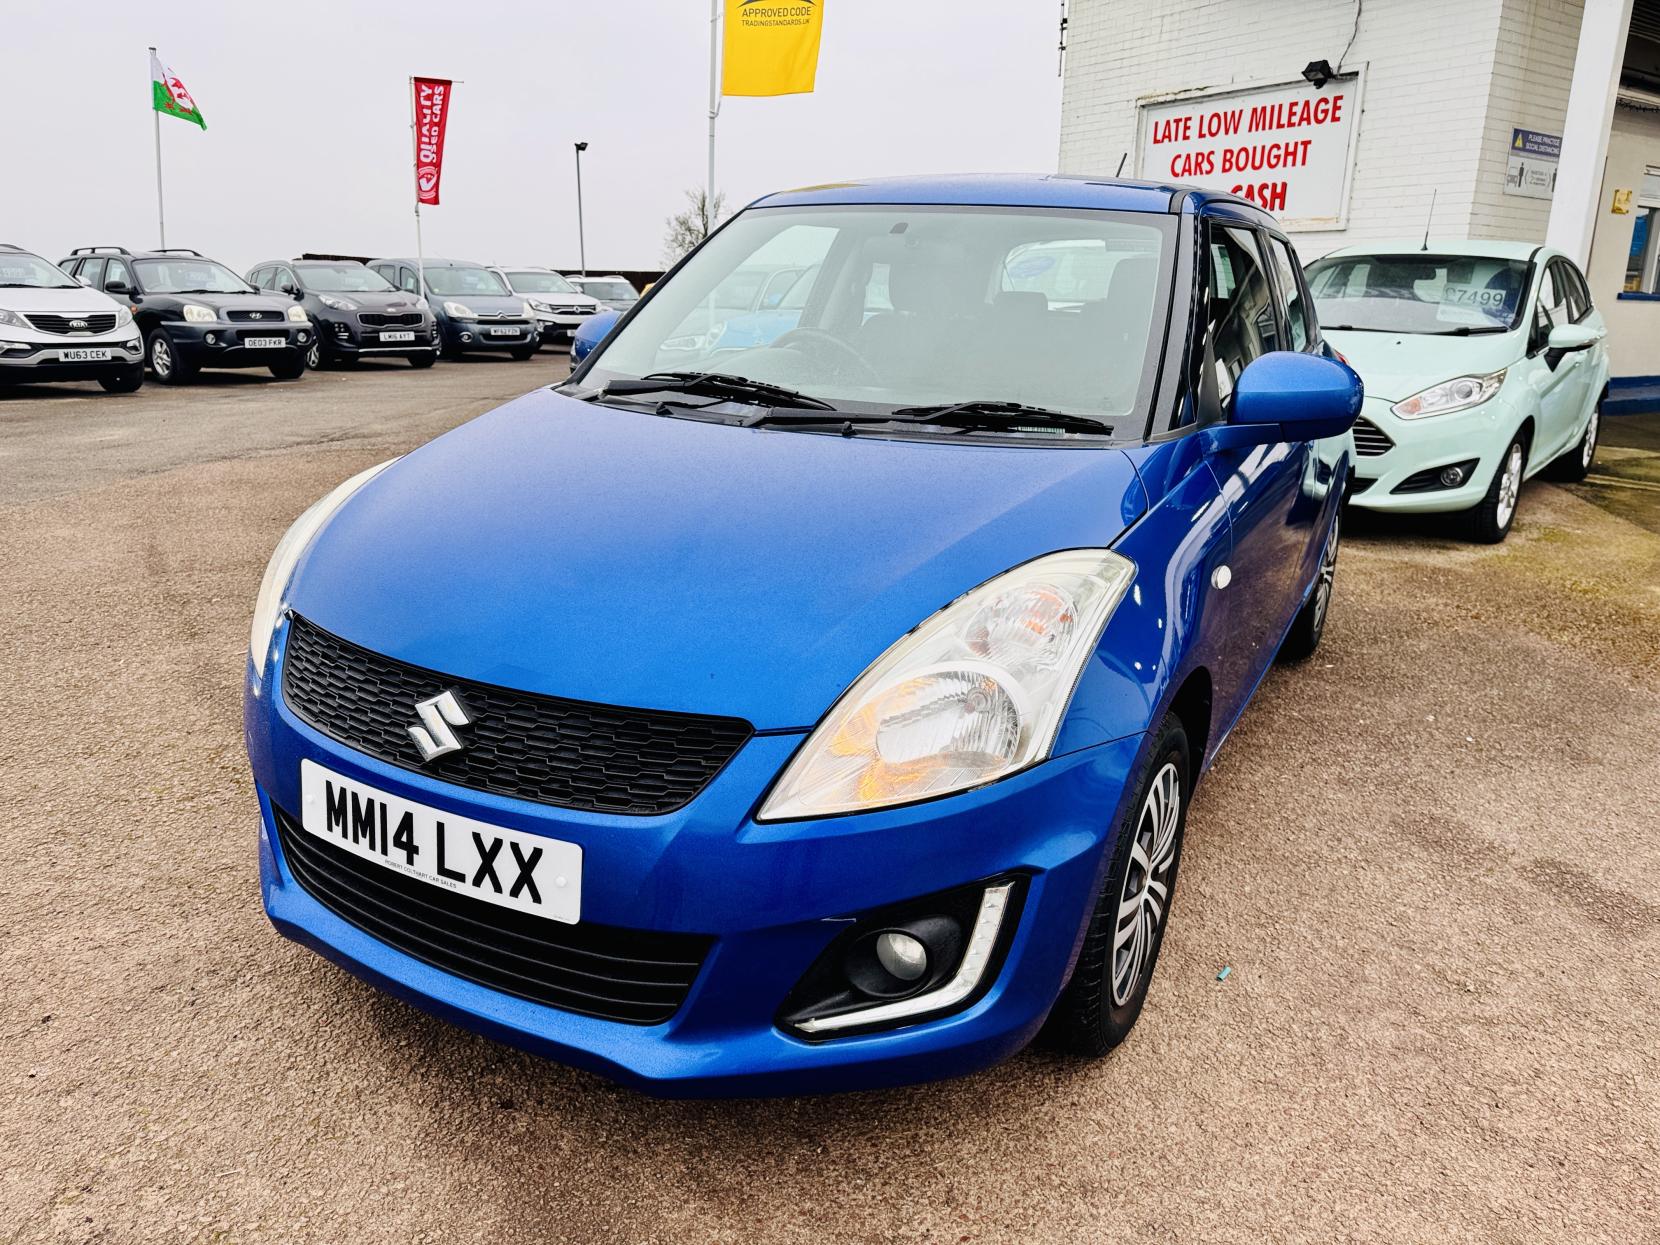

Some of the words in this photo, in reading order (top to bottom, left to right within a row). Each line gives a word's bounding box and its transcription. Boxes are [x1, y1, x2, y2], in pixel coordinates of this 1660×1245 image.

[742, 8, 789, 17] APPROVED
[790, 6, 812, 16] CODE
[432, 85, 444, 122] CARS
[1153, 116, 1192, 144] LATE
[1198, 109, 1243, 139] LOW
[1248, 95, 1344, 133] MILEAGE
[420, 84, 432, 162] QUALITY
[430, 126, 439, 162] USED
[1170, 150, 1215, 178] CARS
[1221, 140, 1312, 173] BOUGHT
[63, 351, 88, 360] WU63
[89, 350, 108, 359] CEK
[268, 338, 282, 346] FKR
[325, 780, 420, 866] MM14
[436, 820, 543, 905] LXX
[384, 859, 403, 869] ROBERT
[428, 875, 440, 883] CAR
[440, 879, 457, 889] SALES
